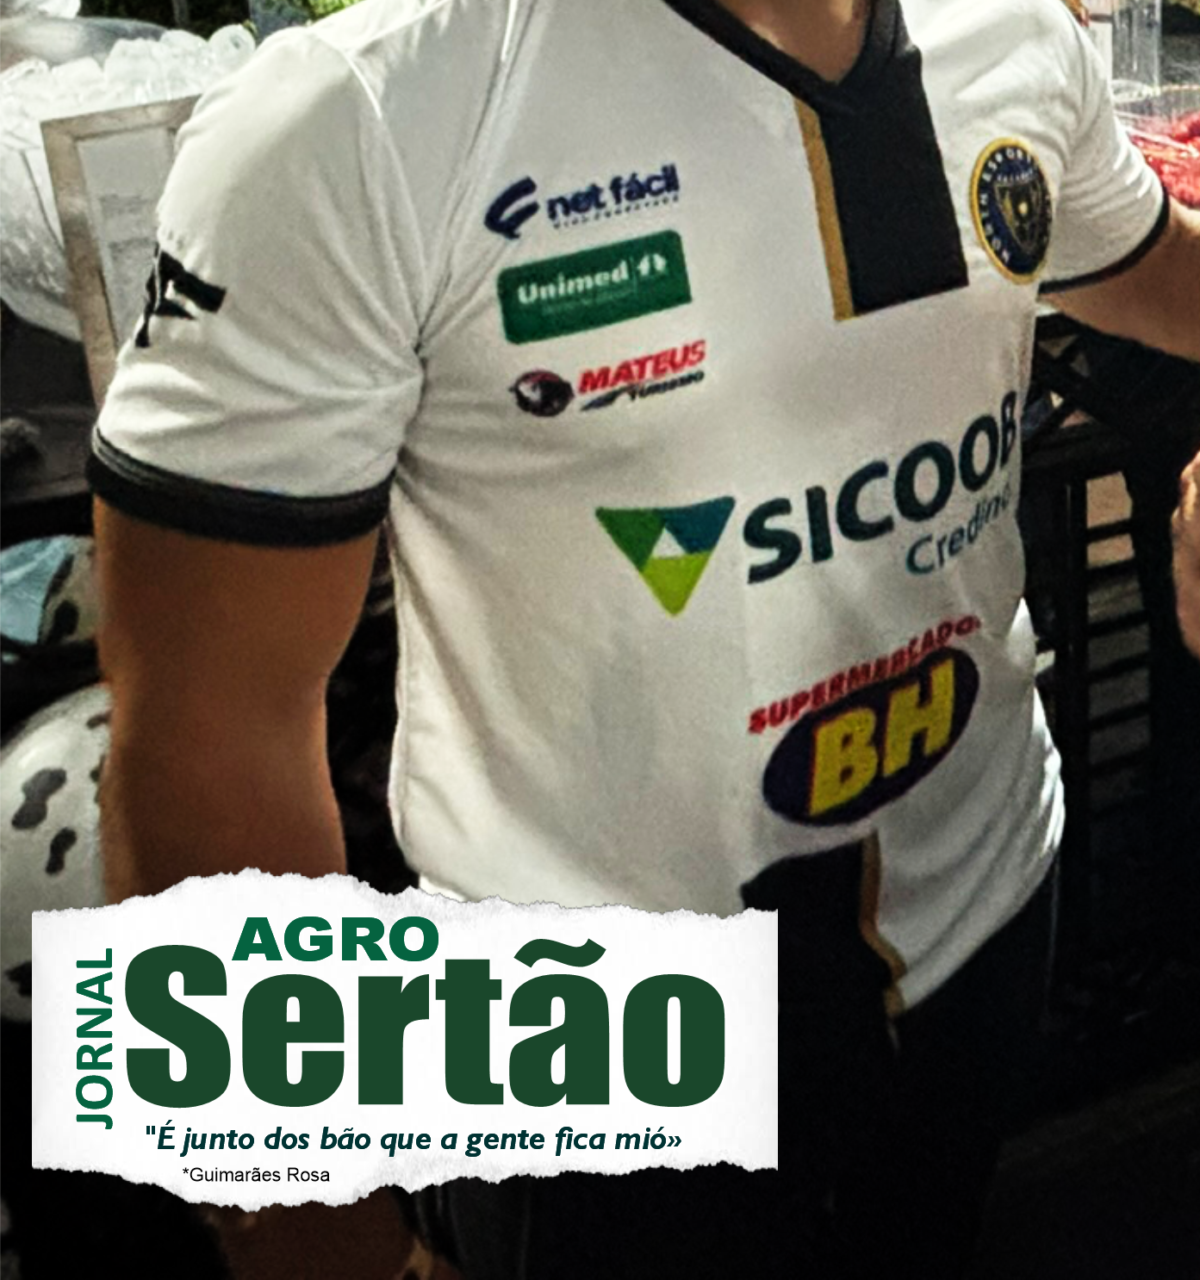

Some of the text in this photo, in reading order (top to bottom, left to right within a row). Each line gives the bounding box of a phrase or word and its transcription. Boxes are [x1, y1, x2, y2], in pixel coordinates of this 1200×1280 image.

[517, 260, 629, 304] Unimed
[578, 339, 706, 395] MATEUS
[742, 390, 1017, 585] SICOOB
[808, 658, 955, 815] BH
